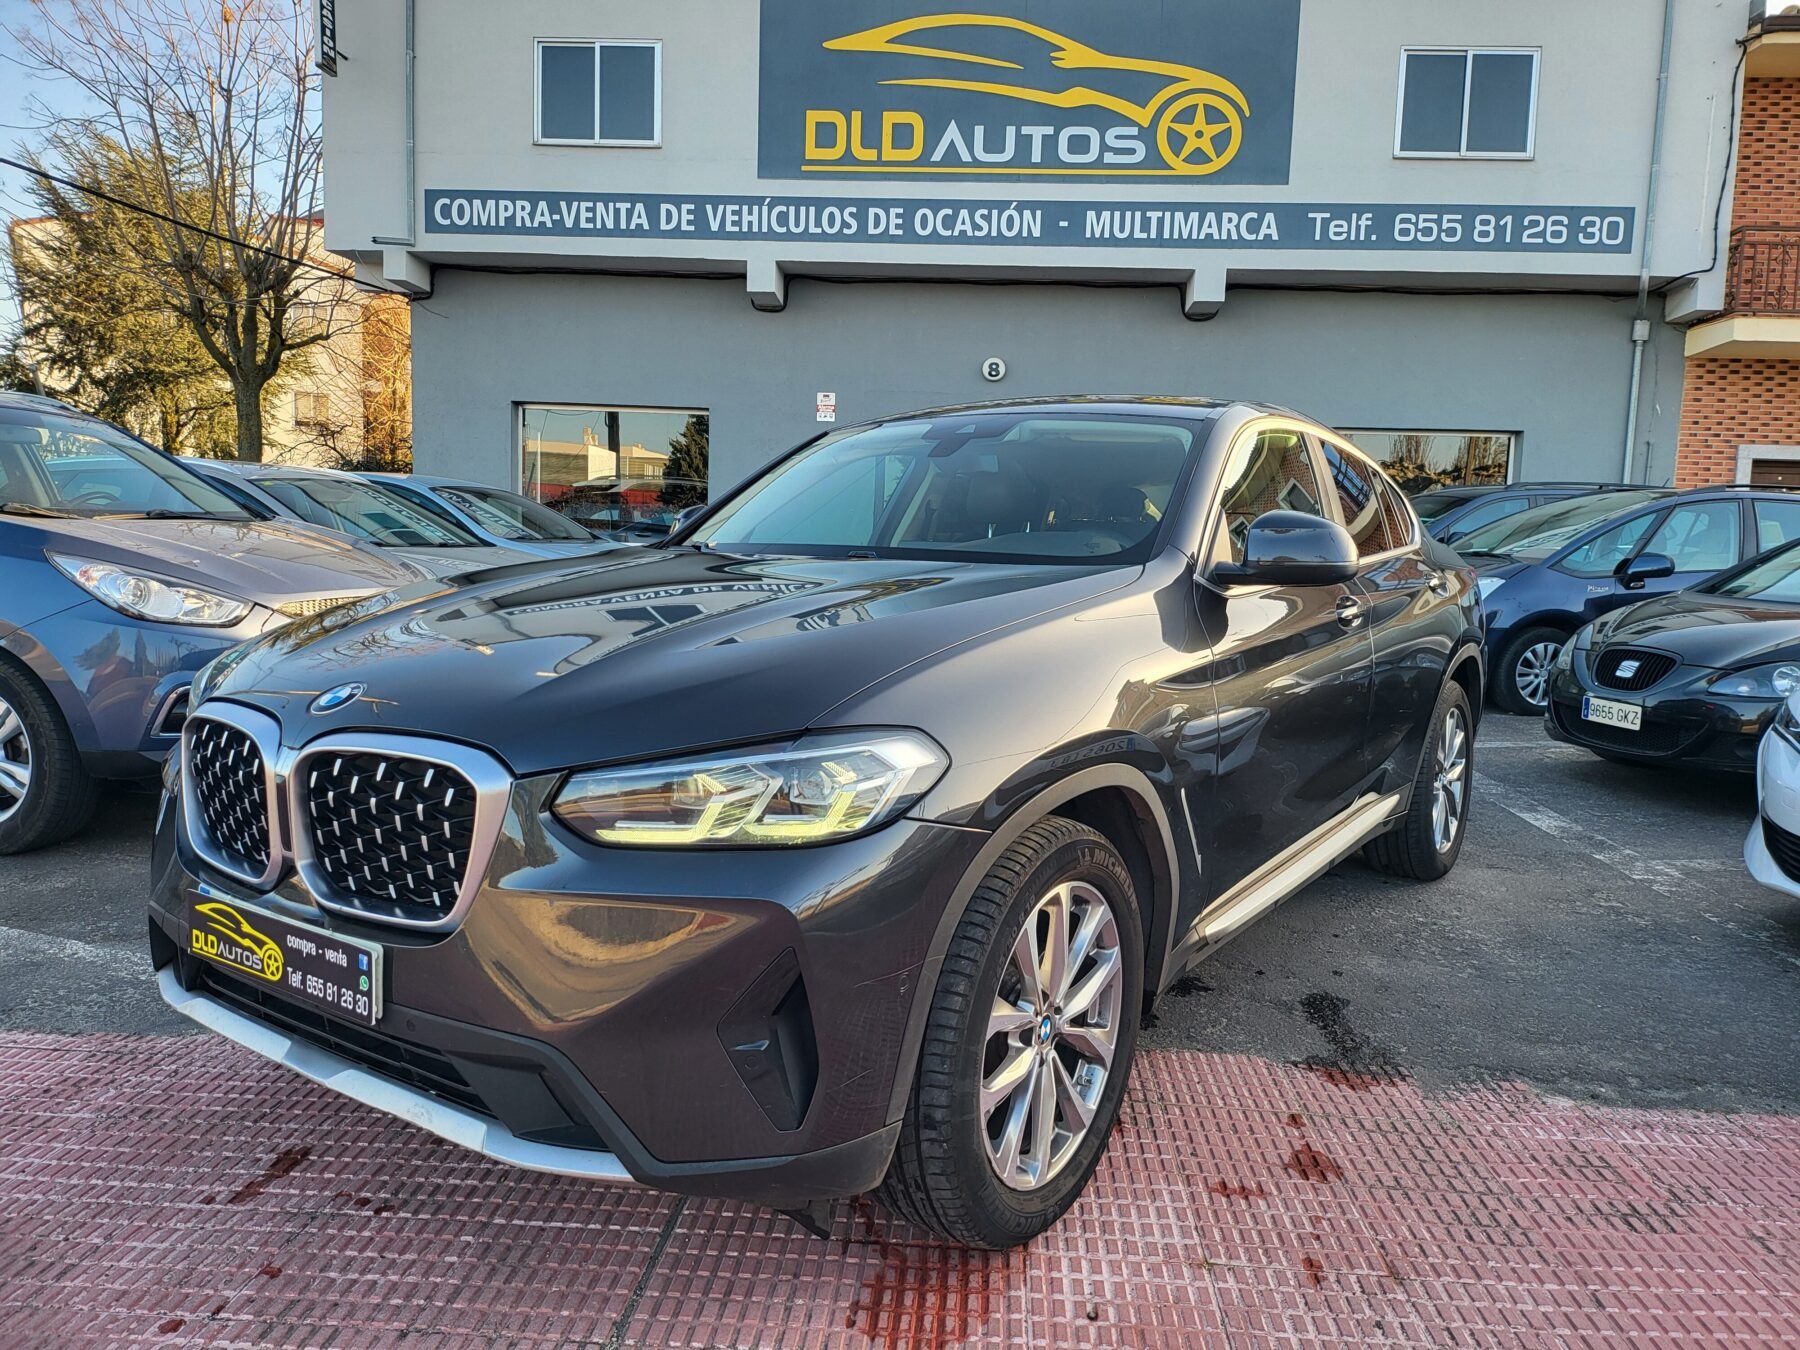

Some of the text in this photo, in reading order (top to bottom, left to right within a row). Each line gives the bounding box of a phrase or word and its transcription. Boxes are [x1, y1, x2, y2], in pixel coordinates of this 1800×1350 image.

[930, 119, 1147, 165] AUTOS
[434, 198, 650, 231] COMPRA-VENTA
[660, 203, 695, 232] DE
[705, 198, 858, 235] VEHÍCULOS
[868, 207, 904, 236] DE
[914, 203, 1042, 238] OCASIÓN
[1085, 210, 1279, 241] MULTIMARCA
[1308, 212, 1377, 241] Telf.
[1393, 213, 1462, 242] 655
[1577, 215, 1625, 245] 30
[988, 362, 1000, 377] 8
[1590, 703, 1639, 725] 9655 GKZ
[218, 941, 263, 970] AUTOS
[286, 934, 317, 958] compra
[324, 947, 348, 968] venta
[286, 967, 369, 1016] Telf. 655 81 26 30
